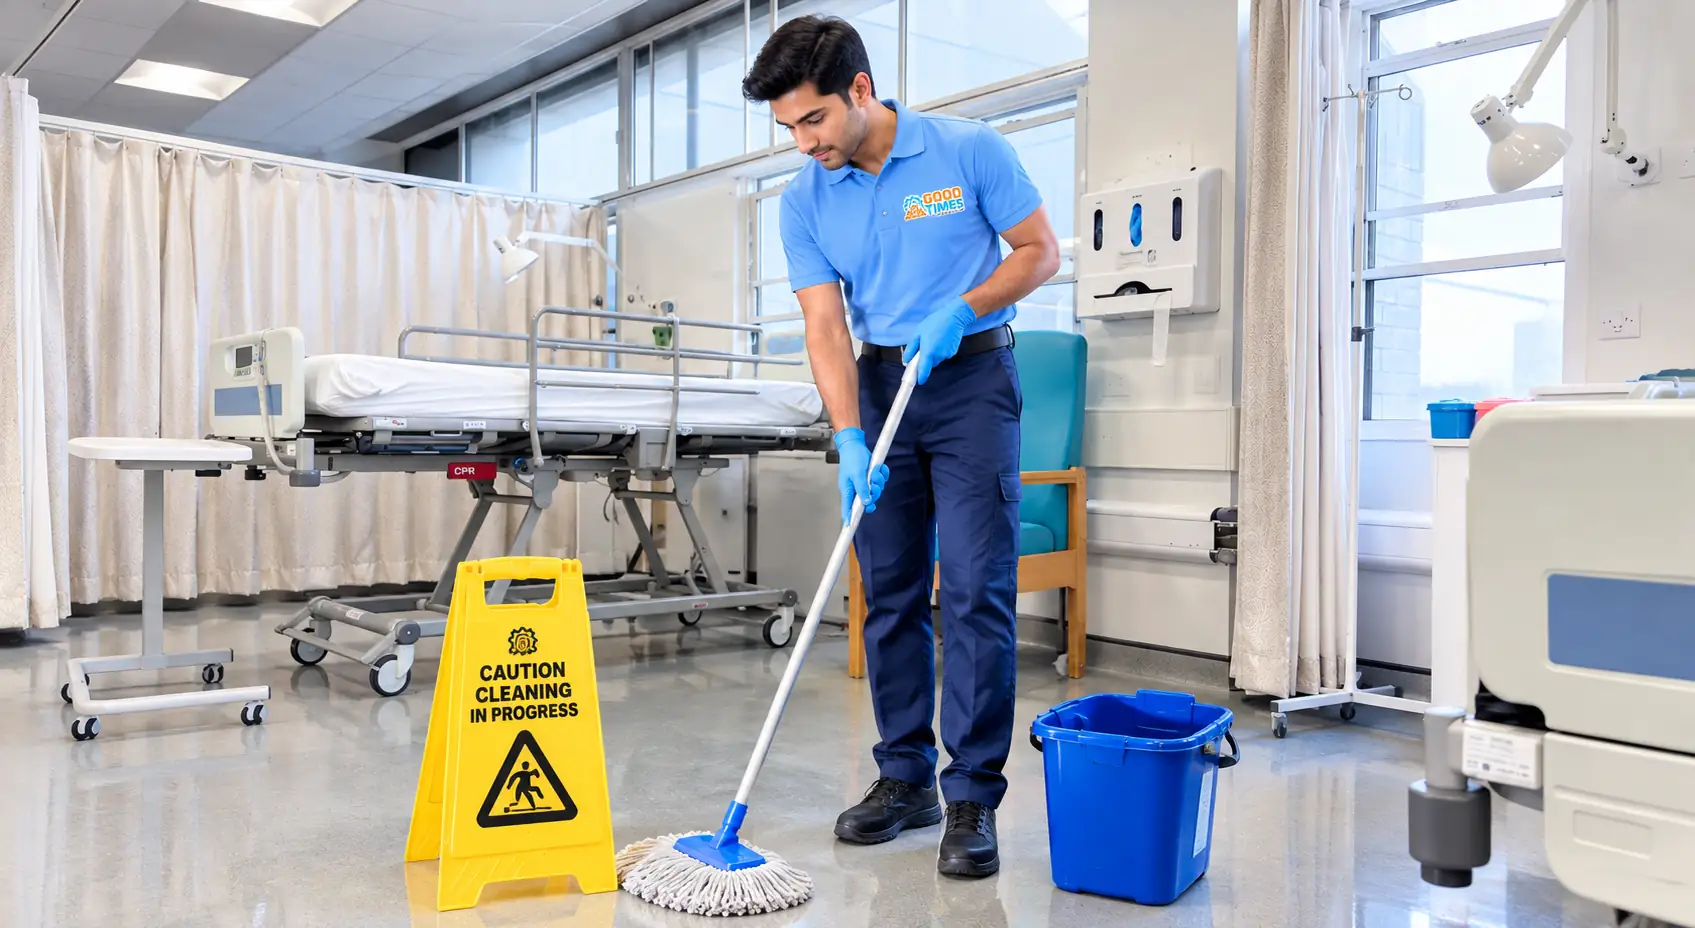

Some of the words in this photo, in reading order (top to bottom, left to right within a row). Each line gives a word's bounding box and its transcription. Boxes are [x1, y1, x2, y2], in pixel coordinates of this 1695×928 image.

[923, 186, 962, 204] GOOD
[925, 198, 964, 216] TIMES
[454, 466, 475, 475] CPR
[480, 661, 566, 682] CAUTION
[475, 682, 572, 703] CLEANING
[470, 707, 487, 723] IN
[491, 702, 579, 722] PROGRESS
